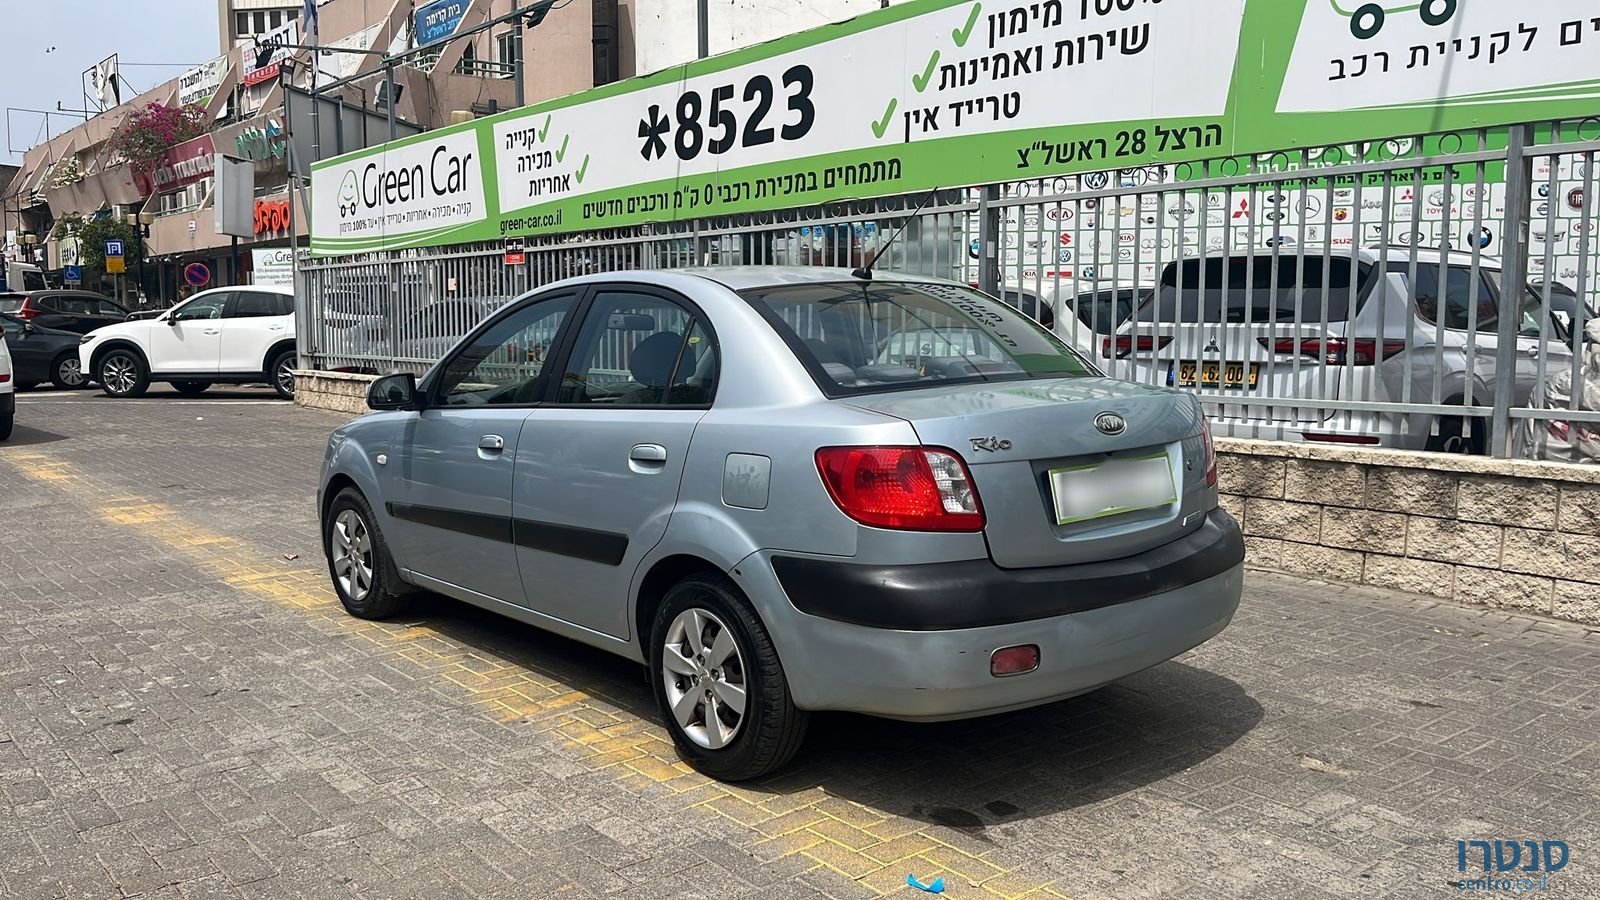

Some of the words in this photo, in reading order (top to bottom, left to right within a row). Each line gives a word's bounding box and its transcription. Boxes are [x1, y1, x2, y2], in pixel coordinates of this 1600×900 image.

[447, 4, 461, 18] בית
[988, 0, 1062, 48] מימון
[1052, 23, 1150, 69] שירות
[1406, 22, 1538, 69] לקניית
[938, 45, 1043, 91] ואמינות
[1328, 51, 1389, 81] רכב
[949, 91, 1020, 127] טרייד
[903, 105, 939, 142] אין
[506, 128, 535, 150] קנייה
[1114, 128, 1147, 158] 28
[1155, 123, 1222, 152] הרצל
[518, 150, 552, 173] מכירה
[363, 163, 424, 208] Green
[431, 145, 471, 195] Car
[755, 171, 818, 198] במכירת
[824, 158, 901, 189] מתמחים
[529, 174, 570, 197] אחריות
[704, 183, 713, 205] 0
[717, 181, 750, 203] רכבי
[456, 202, 472, 217] קניה
[583, 199, 623, 219] חדשים
[627, 193, 668, 213] ורכבים
[1360, 200, 1382, 209] Jee
[1572, 194, 1584, 205] FIA
[406, 209, 428, 222] אחריות
[432, 205, 451, 219] מכירה
[500, 209, 562, 235] green-car.co.il
[353, 220, 367, 231] 100%
[969, 436, 1012, 452] Rio
